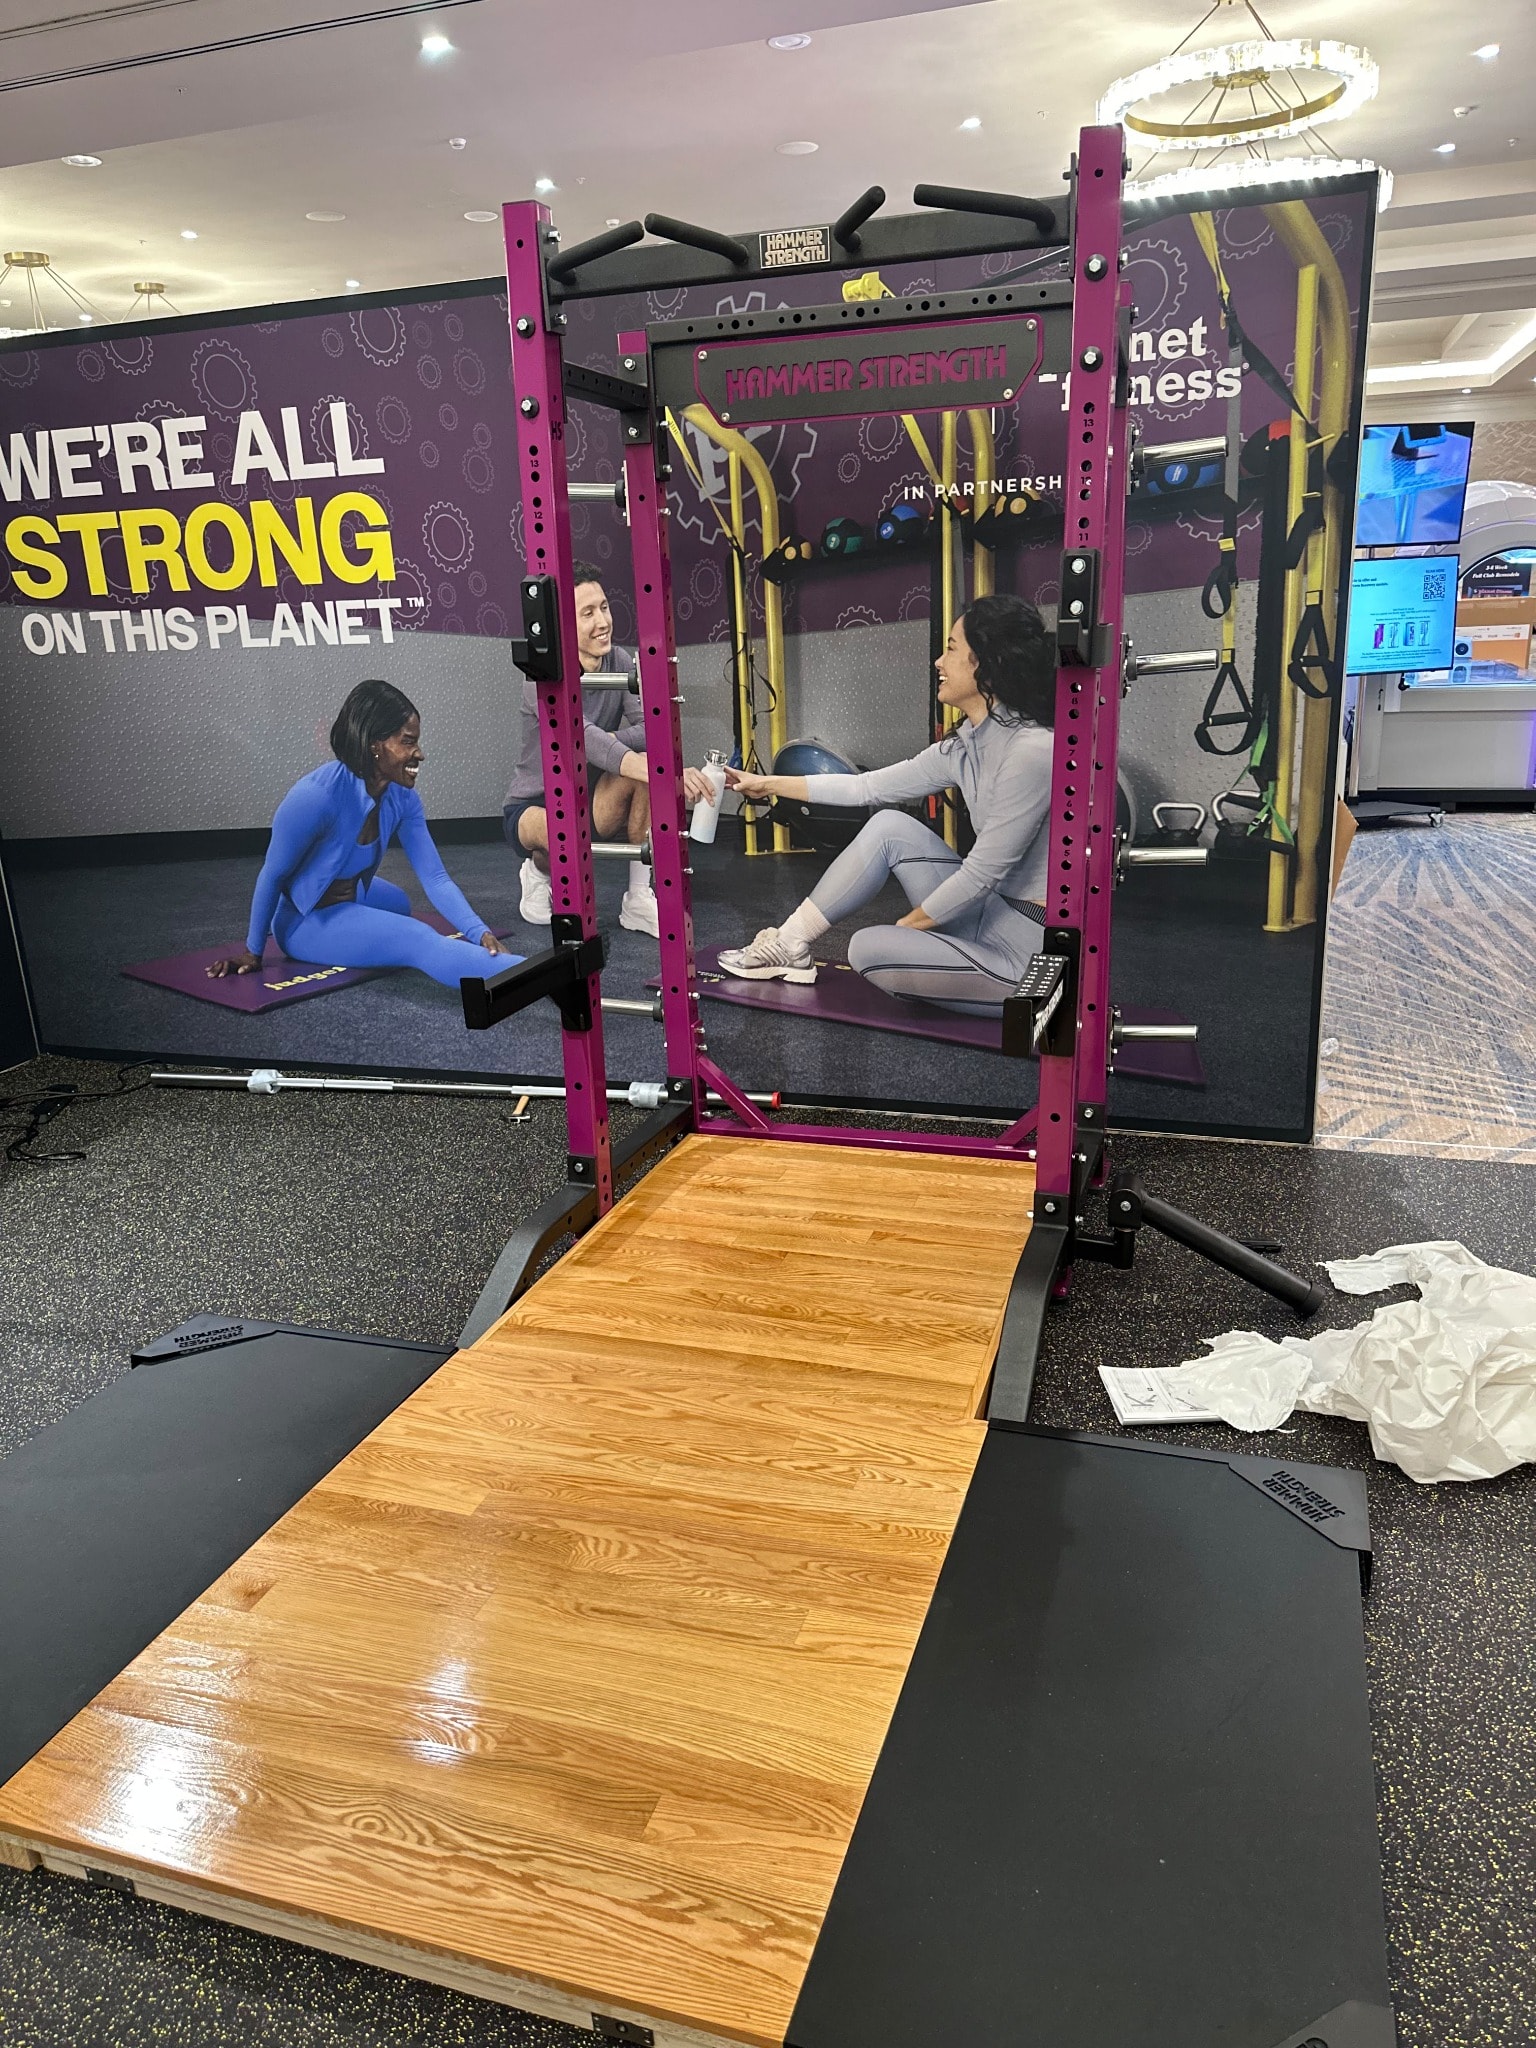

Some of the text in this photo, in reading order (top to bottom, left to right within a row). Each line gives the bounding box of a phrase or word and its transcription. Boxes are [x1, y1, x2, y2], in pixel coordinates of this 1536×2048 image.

[766, 230, 823, 252] HAMMER
[764, 244, 826, 266] STRENGTH
[1130, 315, 1208, 362] net
[725, 344, 1008, 406] HAMMER STRENGTH
[1083, 418, 1095, 428] 13
[0, 402, 385, 501] WE'RE ALL
[529, 459, 541, 469] 13
[904, 475, 1063, 501] IN PARTNERSH
[533, 510, 544, 520] 12
[5, 491, 397, 599] STRONG
[1079, 533, 1089, 541] 11
[537, 562, 547, 570] 11
[22, 612, 87, 656] ON
[89, 607, 200, 653] THIS
[204, 598, 402, 650] PLANET
[1262, 1477, 1331, 1523] HAMMER
[1271, 1470, 1346, 1519] STRENGTH
